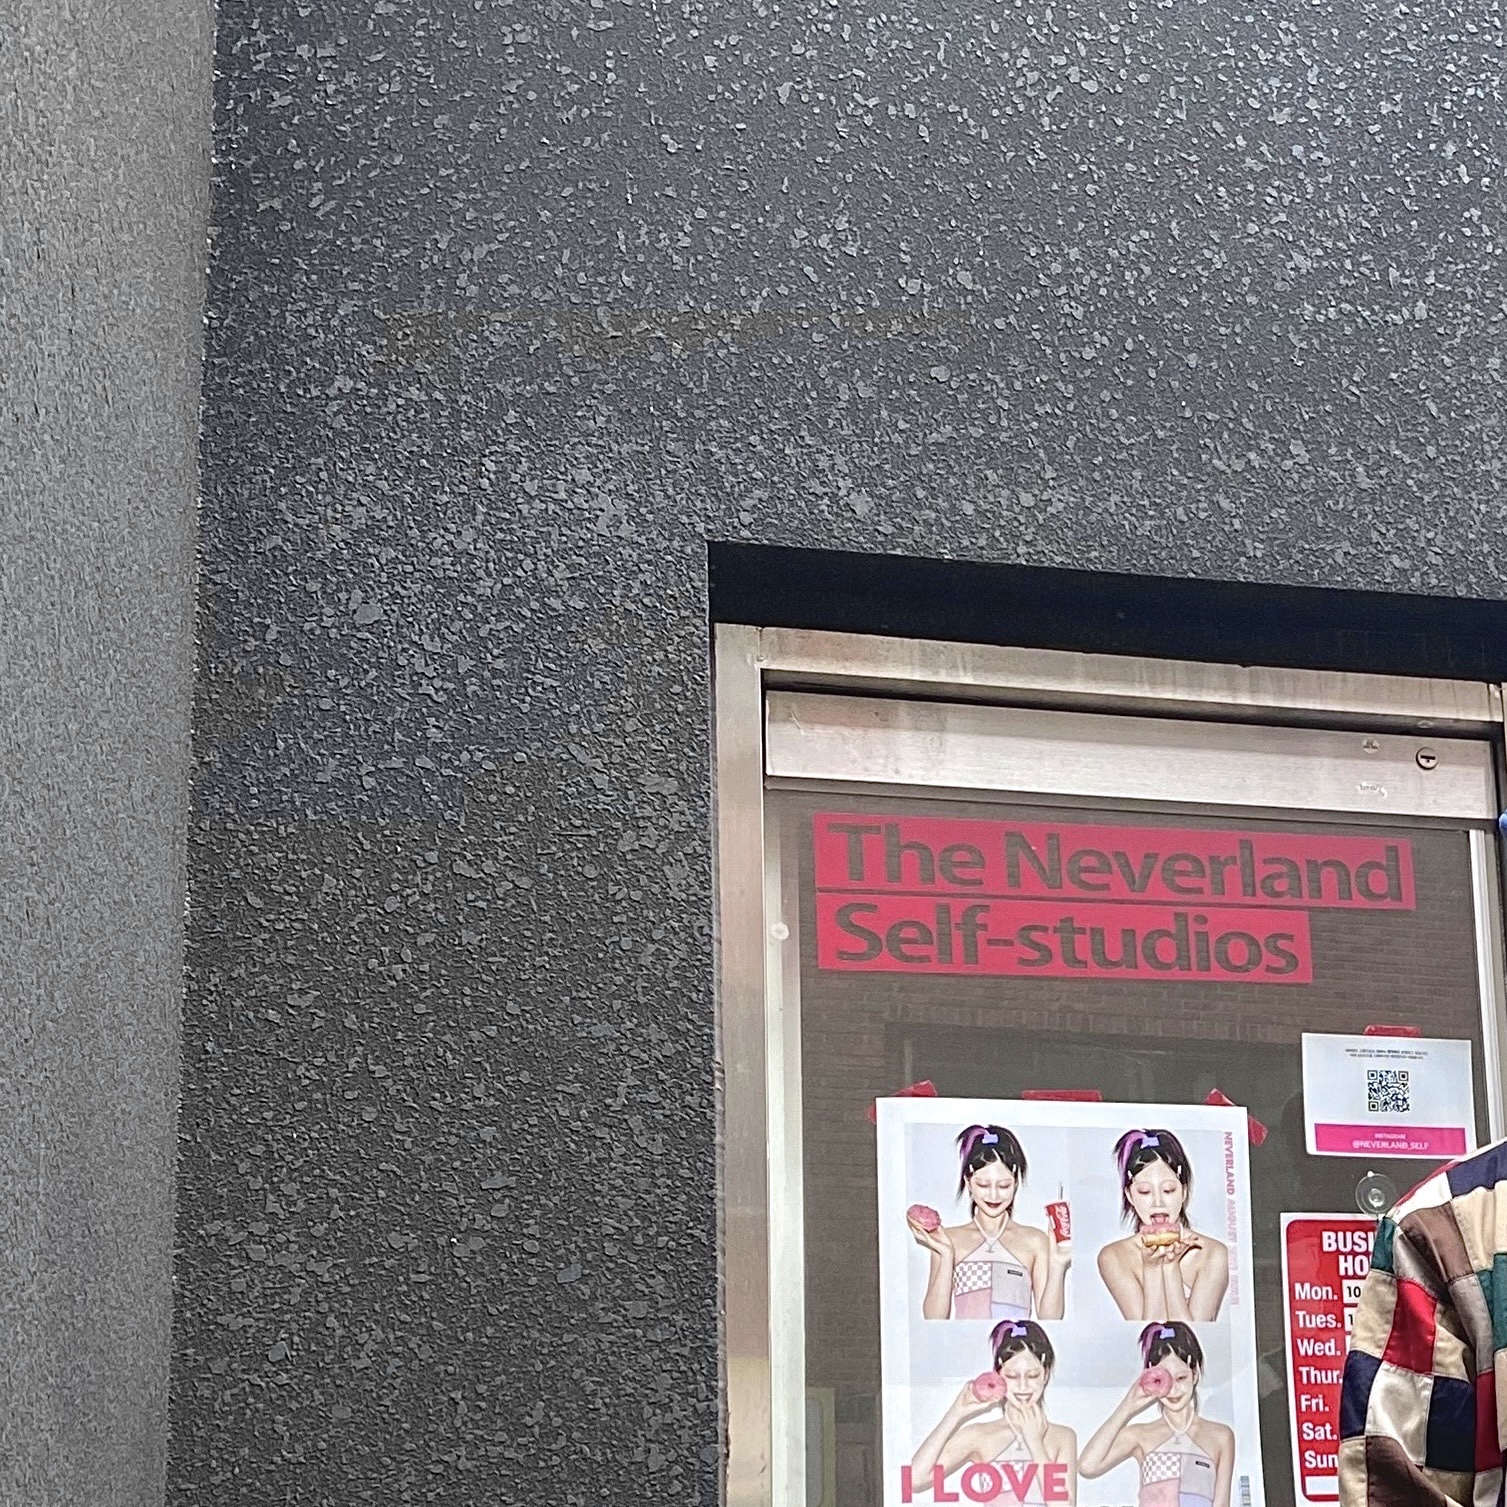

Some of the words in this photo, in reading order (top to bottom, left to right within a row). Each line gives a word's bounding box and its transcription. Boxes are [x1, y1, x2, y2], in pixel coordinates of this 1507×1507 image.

[828, 822, 985, 887] The
[1004, 831, 1400, 902] Neverland
[834, 902, 1300, 976] Self-studios
[1224, 1131, 1236, 1196] NEVERLAND
[1338, 1254, 1372, 1276] HO
[1294, 1282, 1338, 1300] Mon.
[1347, 1286, 1361, 1298] 10
[1295, 1310, 1341, 1328] Tues.
[1296, 1338, 1341, 1356] Wed.
[1298, 1366, 1342, 1384] Thur.
[1300, 1394, 1330, 1412] Fri.
[1302, 1422, 1338, 1440] Sat.
[901, 1465, 913, 1503] I
[932, 1462, 1070, 1503] LOVE
